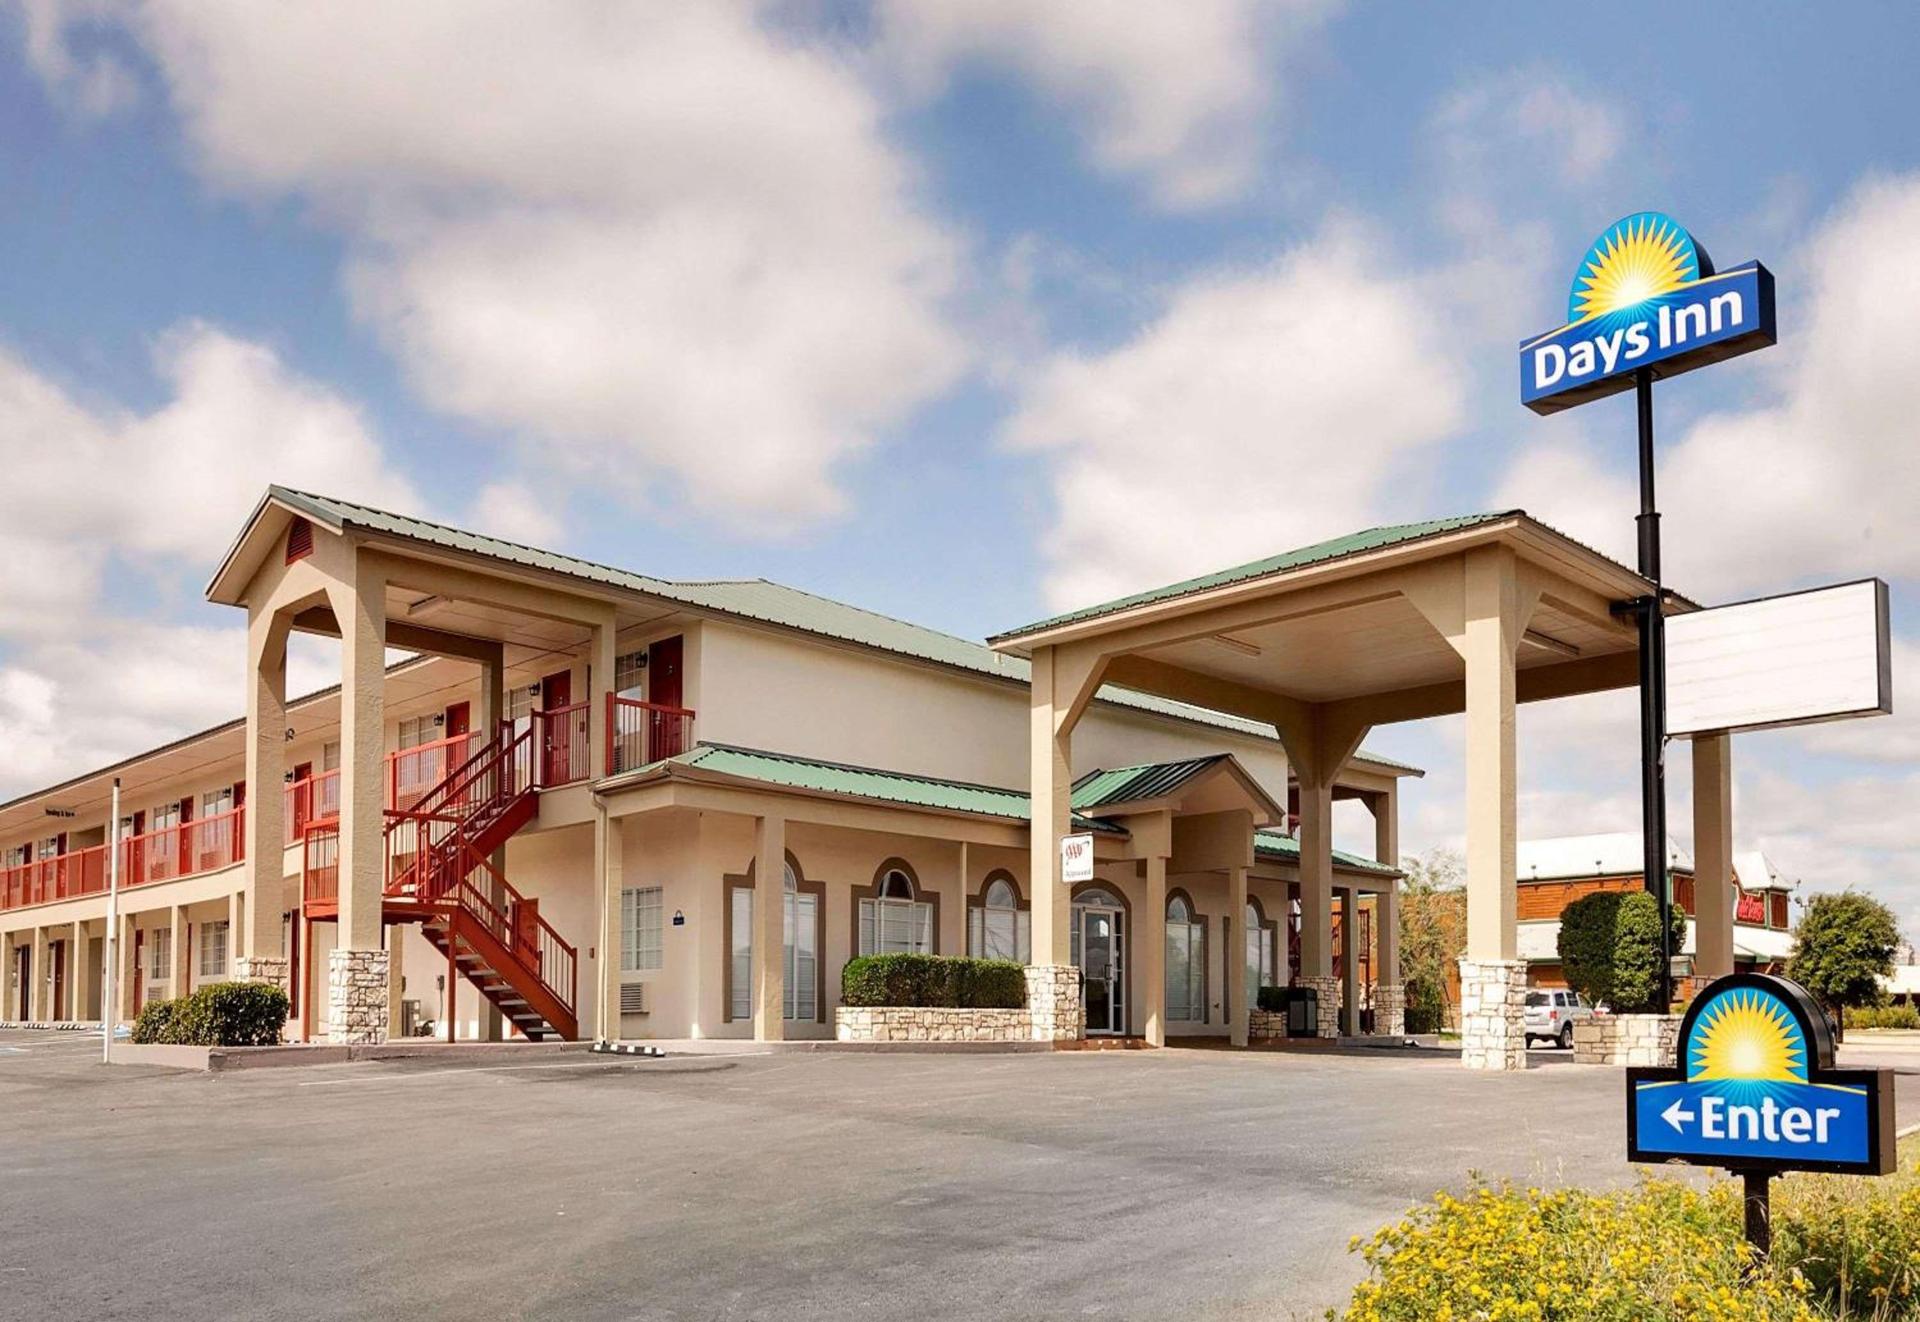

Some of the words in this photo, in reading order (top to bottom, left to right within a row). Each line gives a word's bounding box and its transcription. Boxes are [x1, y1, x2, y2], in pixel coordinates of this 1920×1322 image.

[1534, 321, 1649, 389] Days
[1658, 291, 1742, 349] Inn
[1701, 1096, 1840, 1144] Enter
